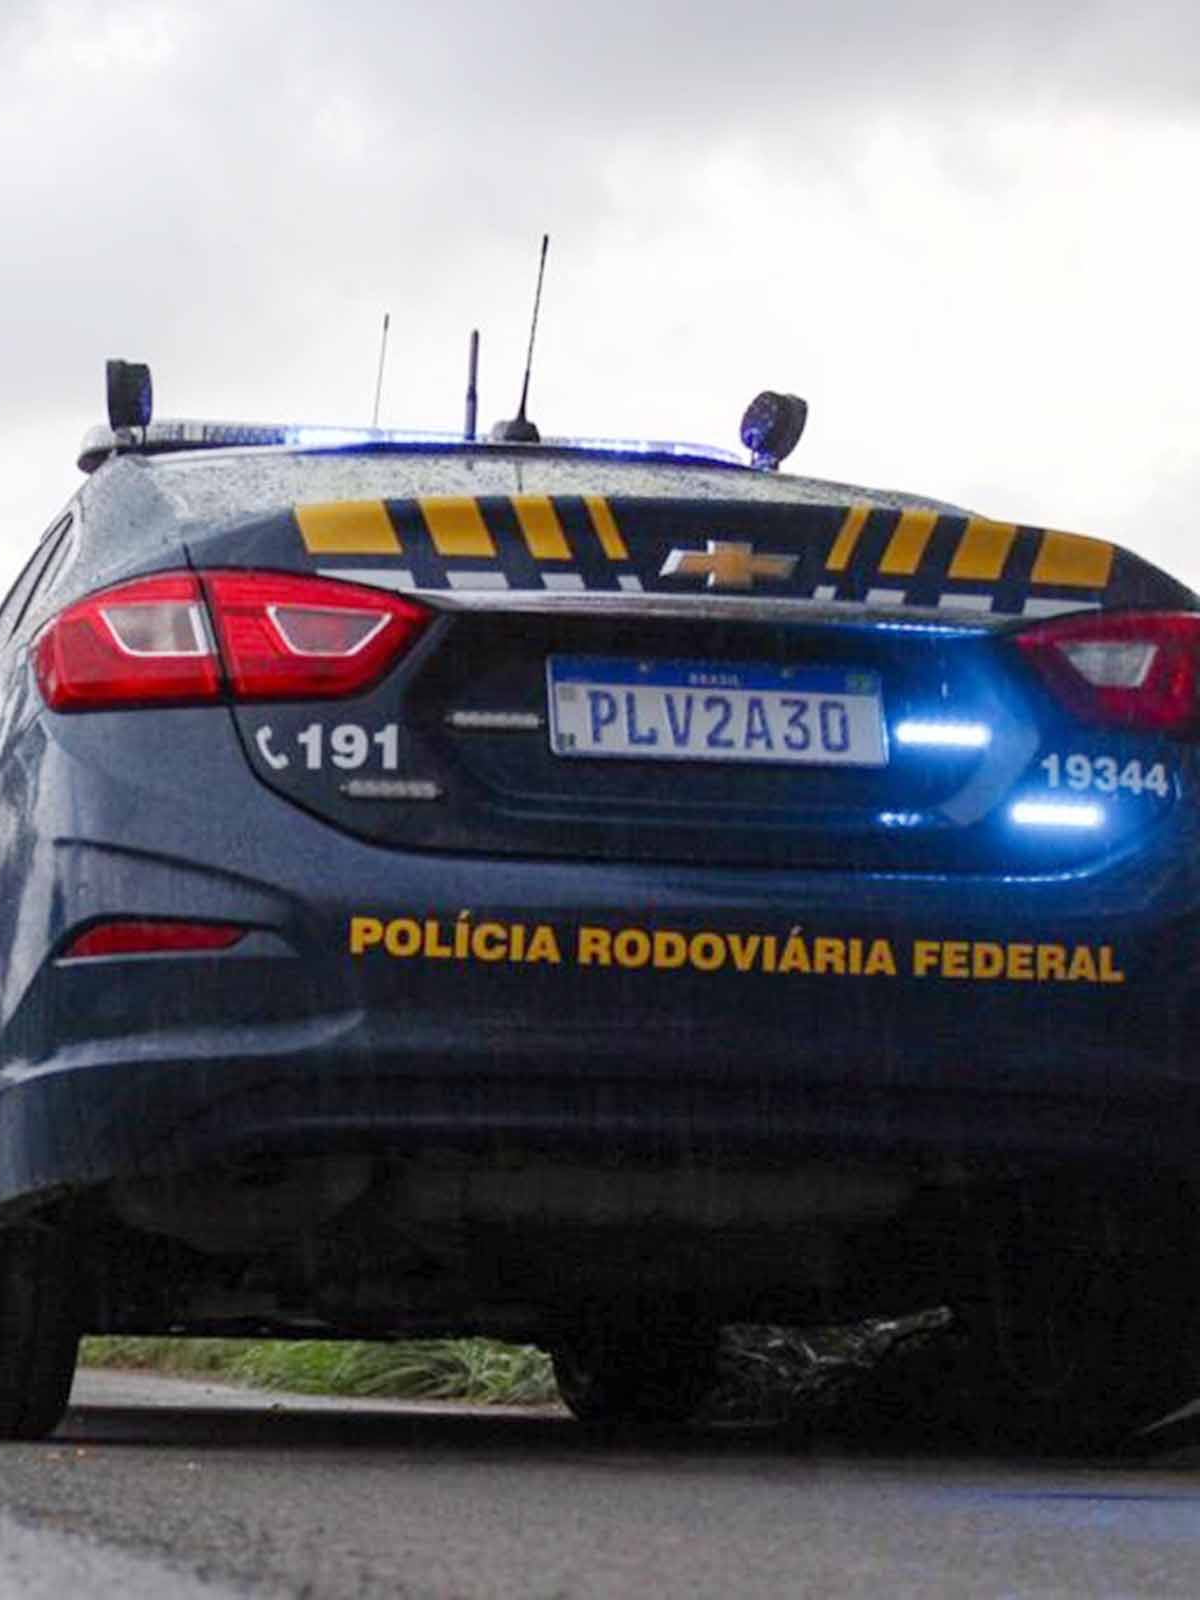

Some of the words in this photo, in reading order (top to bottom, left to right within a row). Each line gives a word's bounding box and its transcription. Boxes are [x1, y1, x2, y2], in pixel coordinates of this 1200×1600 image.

[297, 723, 399, 770] 191
[587, 689, 850, 753] PLV2A30
[1041, 753, 1169, 798] 19344
[350, 911, 560, 963] POLÍCIA
[578, 927, 897, 975] RODOVIÁRIA
[915, 943, 1125, 983] FEDERAL
